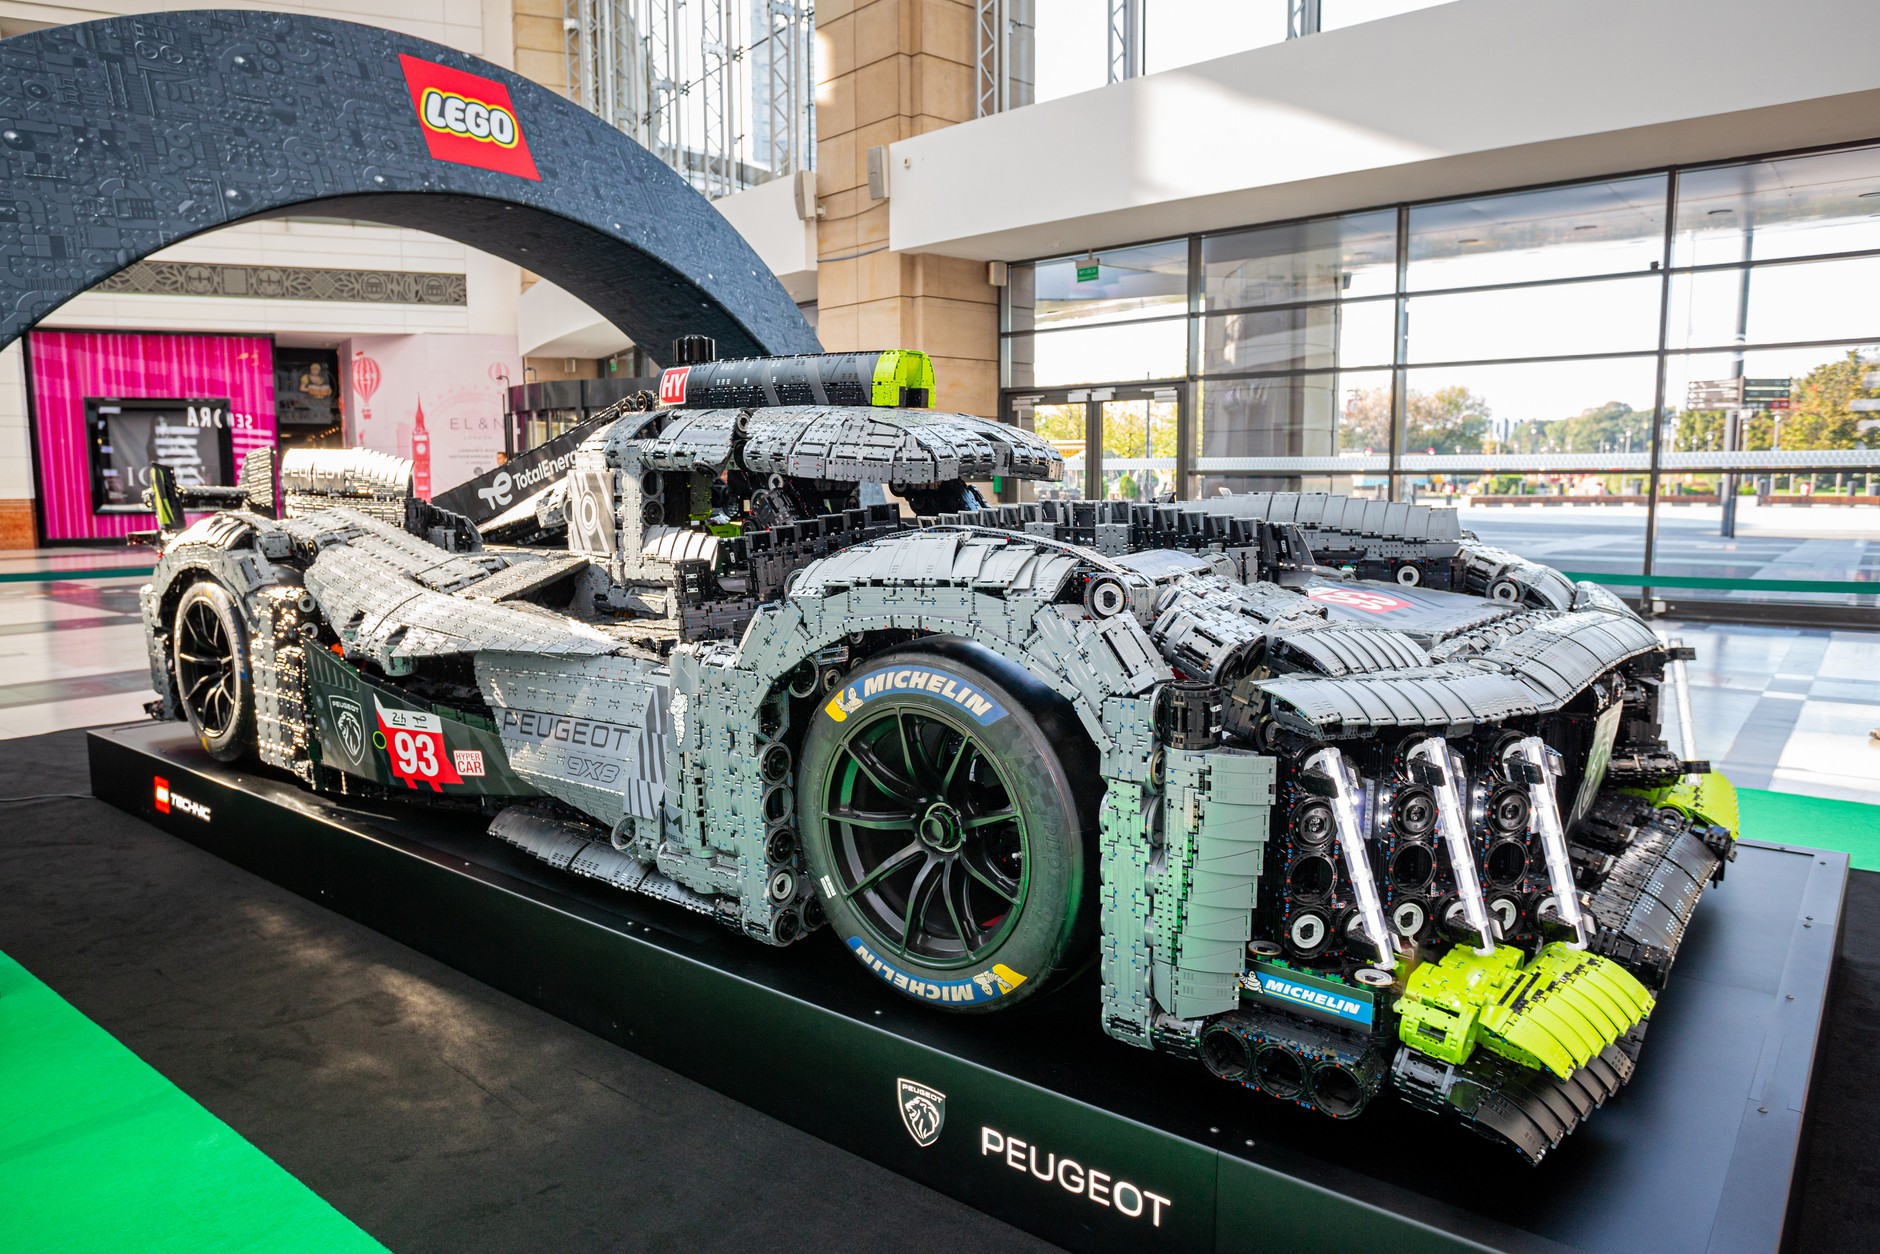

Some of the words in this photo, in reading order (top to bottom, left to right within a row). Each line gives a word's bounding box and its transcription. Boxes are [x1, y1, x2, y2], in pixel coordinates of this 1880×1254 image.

[424, 90, 516, 145] LEGO
[661, 373, 687, 398] HY
[332, 700, 360, 713] PEUGEOT
[864, 670, 993, 717] MICHELIN
[503, 711, 631, 751] PEUGEOT
[394, 731, 439, 777] 93
[456, 752, 481, 762] HYPER
[457, 761, 483, 774] CAR
[566, 755, 621, 784] 9X8
[855, 945, 975, 1002] MICHELIN
[1265, 979, 1360, 1015] MICHELIN
[902, 1083, 943, 1103] PEUGEOT
[981, 1126, 1171, 1227] PEUGEOT
